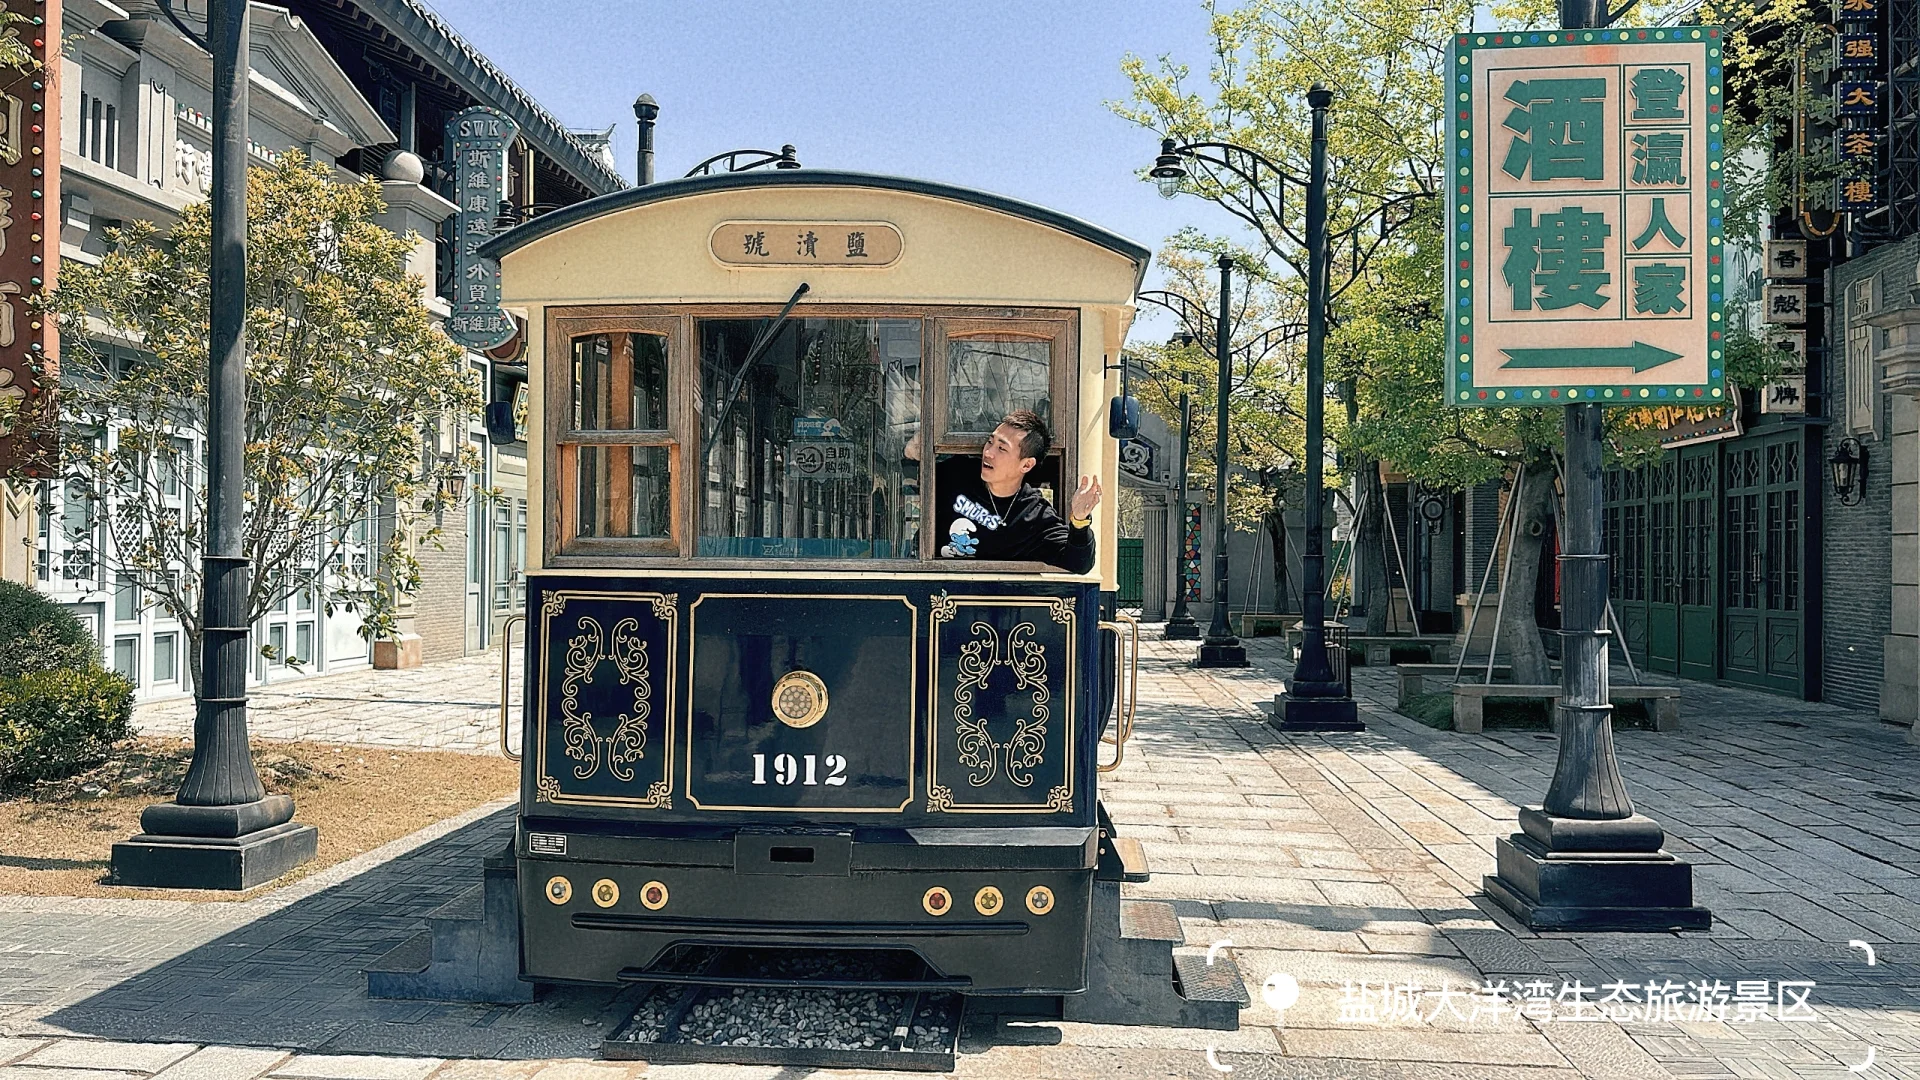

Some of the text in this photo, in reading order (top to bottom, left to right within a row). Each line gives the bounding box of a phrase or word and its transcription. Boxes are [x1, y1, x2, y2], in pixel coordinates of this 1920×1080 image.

[459, 120, 500, 138] SWK
[1501, 78, 1612, 312] 酒樓
[452, 316, 503, 333] 斯維康
[953, 494, 1002, 531] SMURFS
[752, 753, 848, 786] 1912
